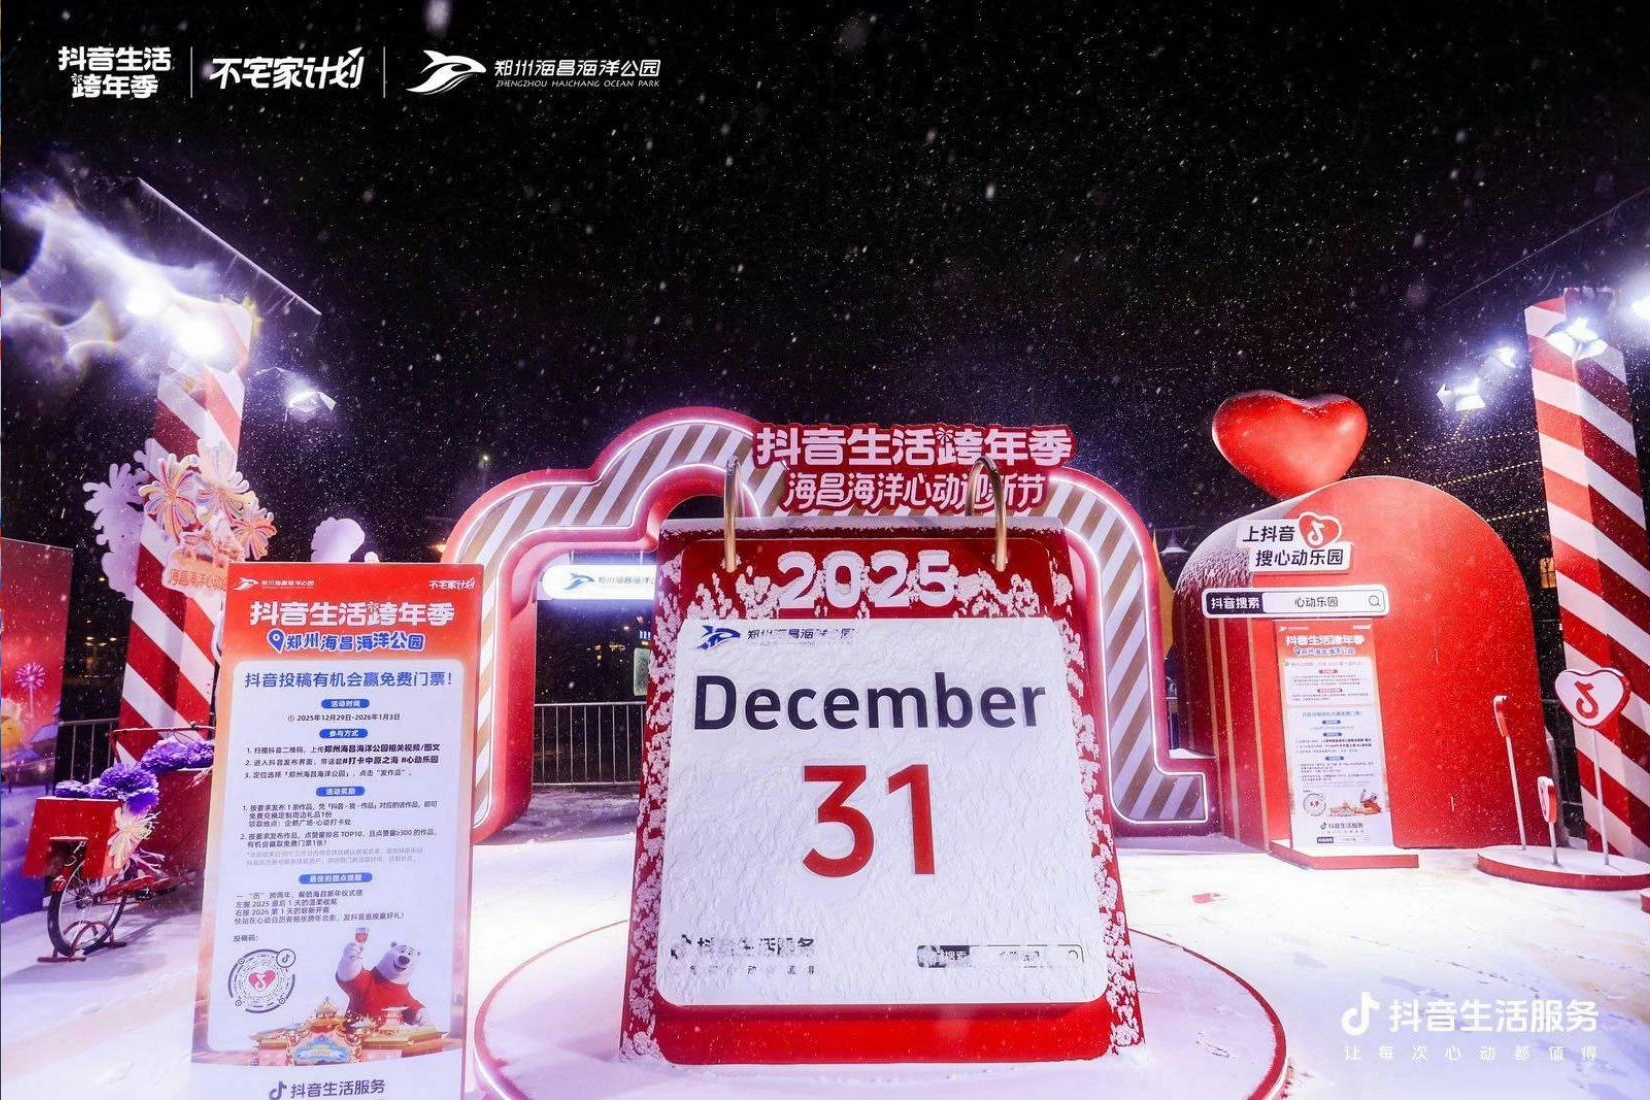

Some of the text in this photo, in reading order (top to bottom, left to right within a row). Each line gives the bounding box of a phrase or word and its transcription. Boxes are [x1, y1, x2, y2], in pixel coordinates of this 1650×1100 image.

[756, 427, 1072, 467] 抖音生活跨年季
[1242, 525, 1295, 543] 上抖音
[1255, 548, 1344, 567] 搜心动乐园
[777, 550, 954, 609] 2025
[250, 601, 455, 626] 抖音生活跨年季
[1210, 596, 1338, 610] 抖音搜索 心动乐园
[694, 672, 1046, 730] December
[802, 764, 935, 878] 31
[291, 1079, 385, 1099] 抖音生活服务
